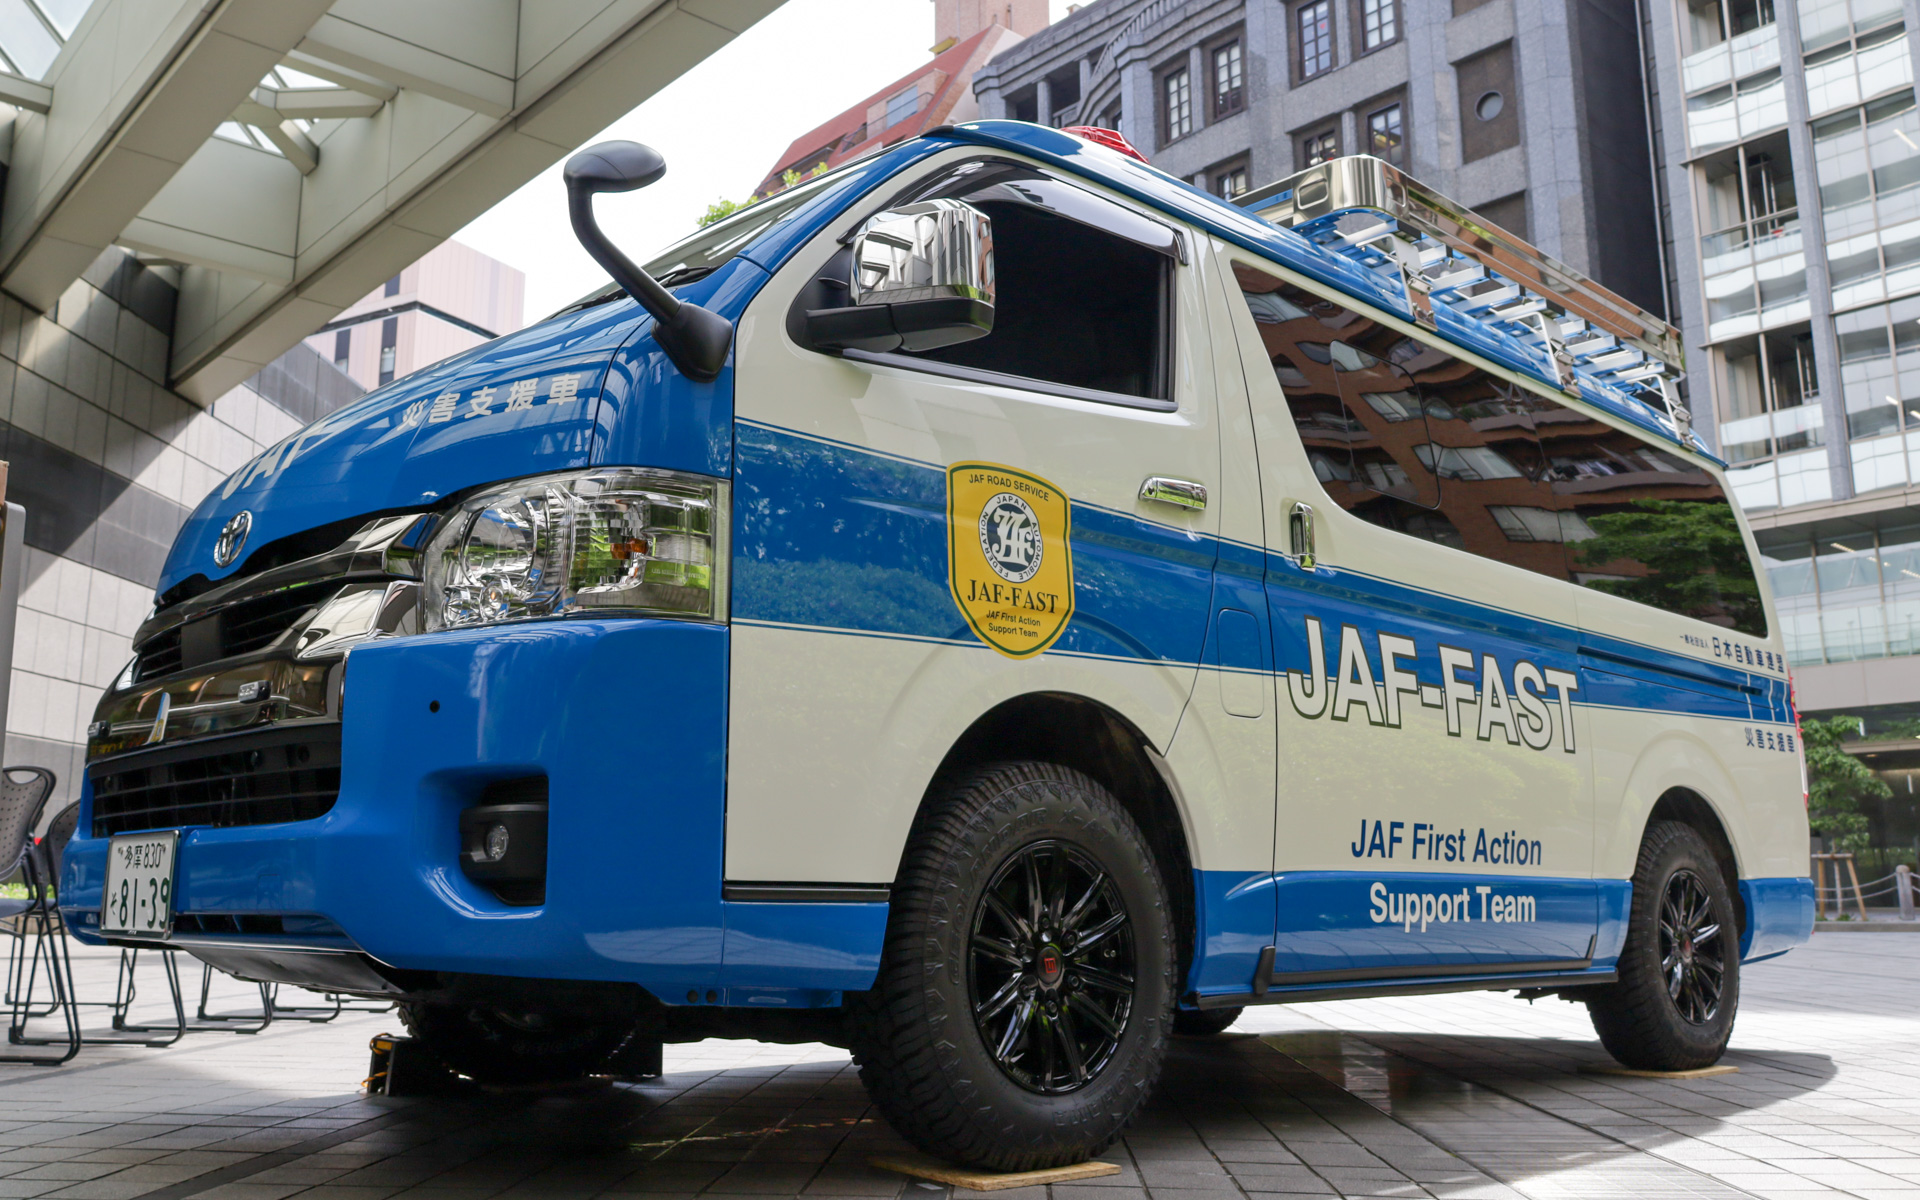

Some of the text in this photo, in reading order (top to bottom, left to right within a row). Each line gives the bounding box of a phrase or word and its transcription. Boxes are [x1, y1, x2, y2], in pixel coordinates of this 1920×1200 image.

[397, 373, 582, 431] 災害支援車
[969, 473, 1050, 502] JAF ROAD SERVICE
[996, 496, 1027, 511] JAPAN
[981, 511, 1009, 579] FEDERATION
[1018, 521, 1042, 581] AUTOMOBILE
[967, 579, 1059, 614] JAF-FAST
[986, 609, 1041, 627] JAF First Action
[988, 622, 1039, 638] Support Team
[1286, 614, 1579, 754] JAF-FAST
[1744, 726, 1795, 753] 災害支援車
[1351, 818, 1542, 866] JAF First Action
[1369, 881, 1536, 933] Support Team
